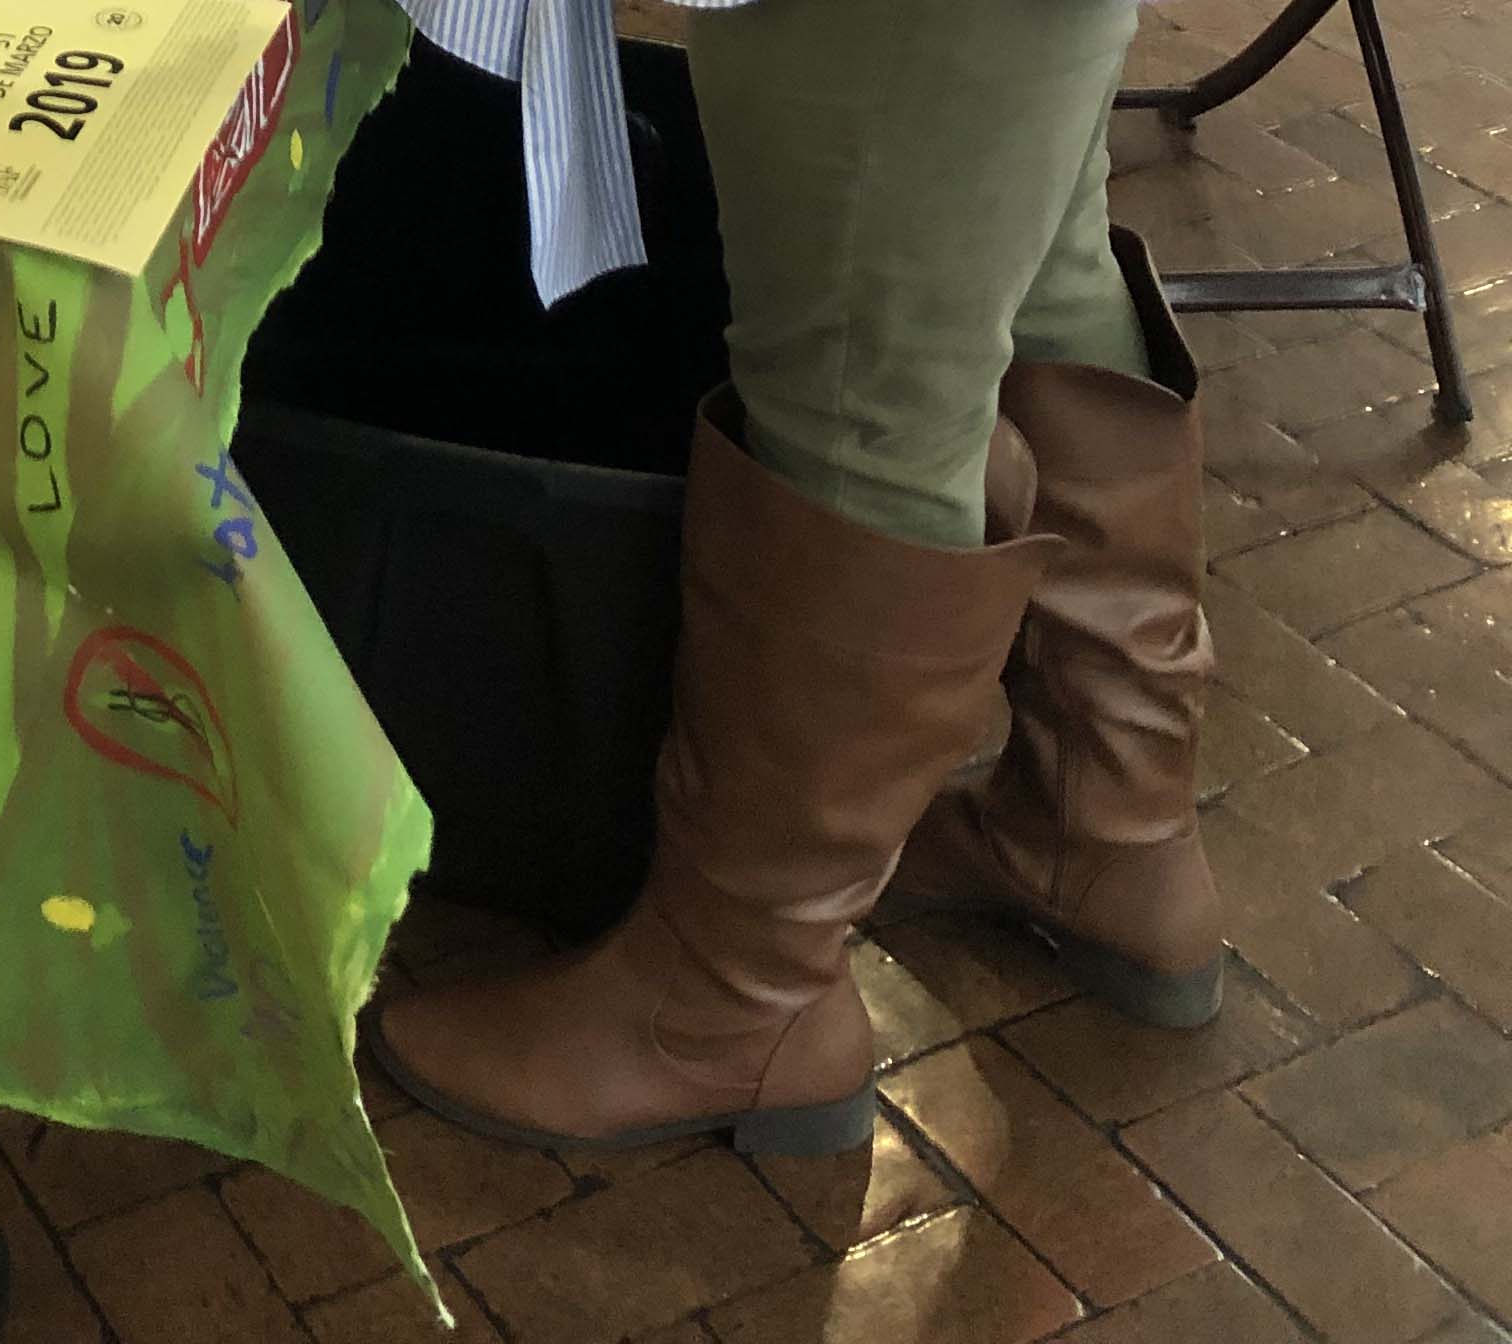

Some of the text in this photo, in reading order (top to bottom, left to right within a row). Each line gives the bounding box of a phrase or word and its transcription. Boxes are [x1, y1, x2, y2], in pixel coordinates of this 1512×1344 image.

[0, 25, 53, 78] MARZO
[8, 50, 125, 141] 2019
[18, 299, 61, 514] LOVE
